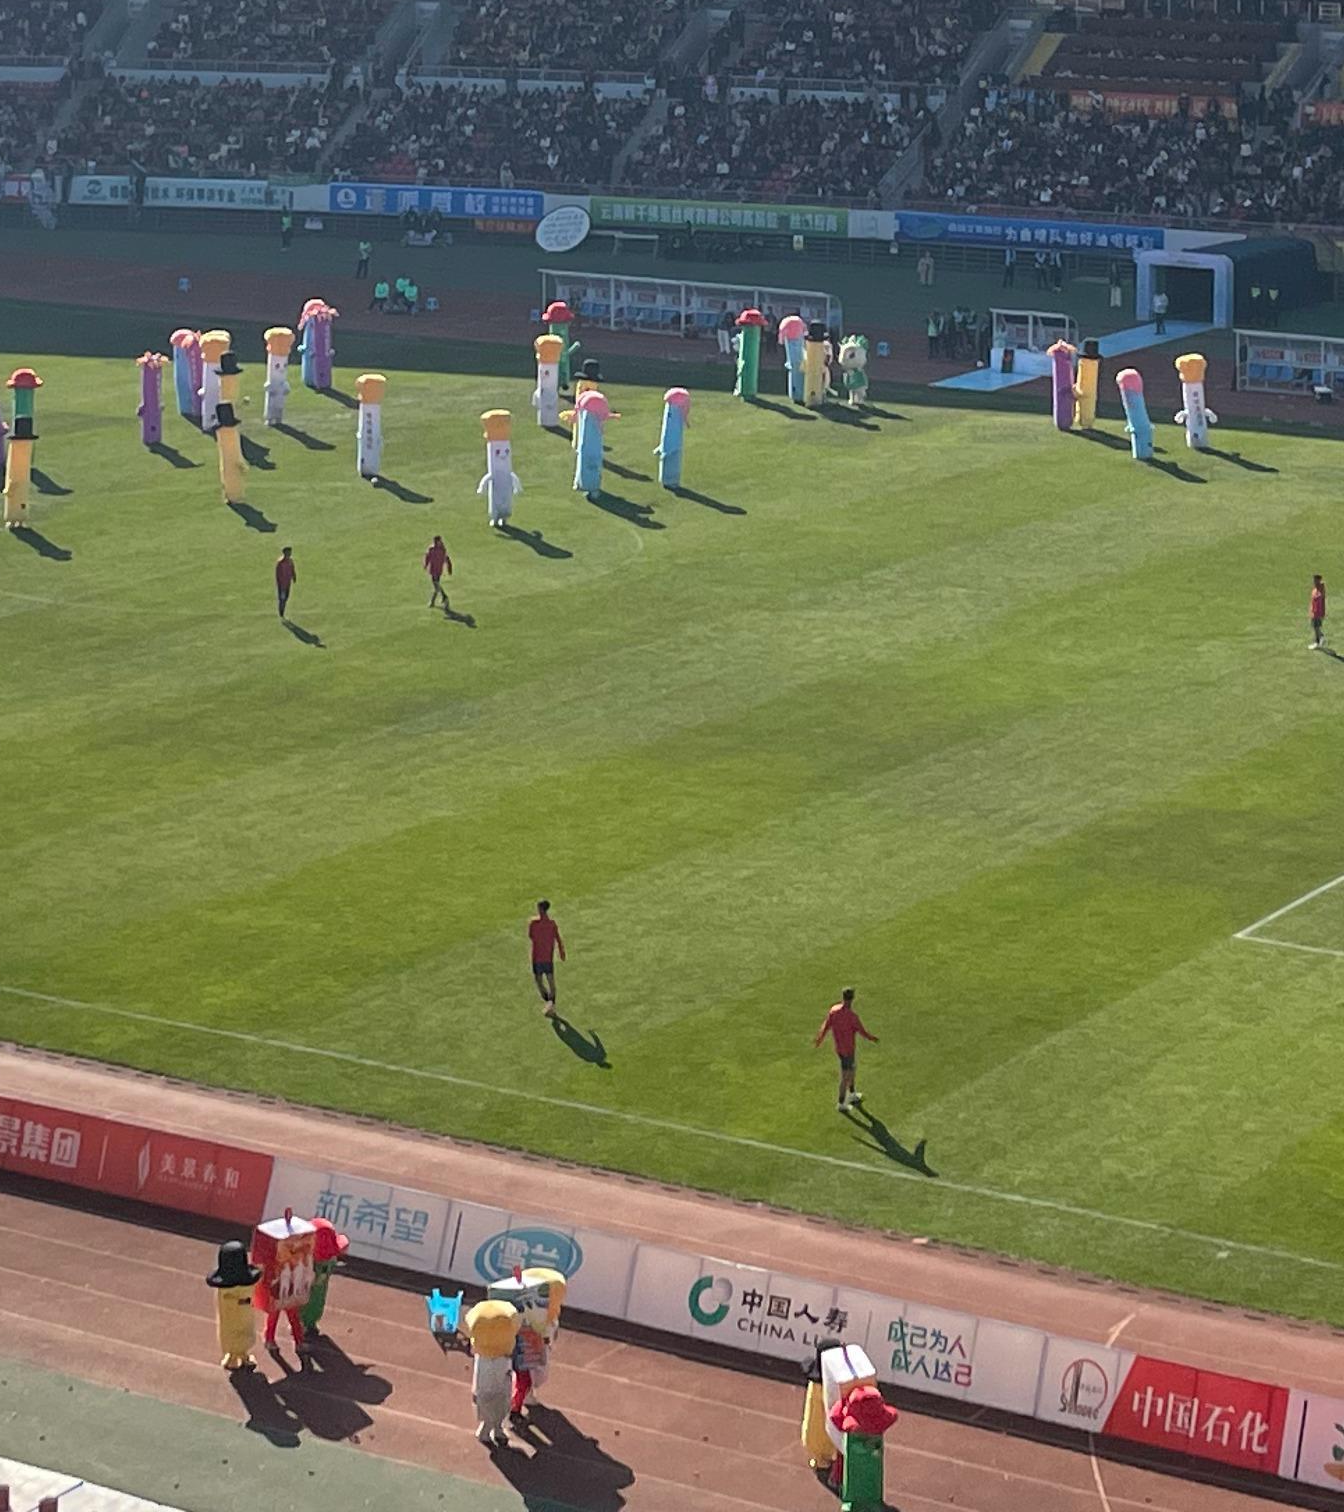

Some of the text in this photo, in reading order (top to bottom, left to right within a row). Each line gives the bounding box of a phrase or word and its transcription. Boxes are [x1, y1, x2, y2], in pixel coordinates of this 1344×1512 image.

[314, 1188, 430, 1245] 新希望
[737, 1317, 795, 1342] CHINA
[741, 1288, 848, 1333] 中国人寿
[888, 1317, 966, 1359] 成己为人
[891, 1348, 972, 1387] 成人达己
[1132, 1384, 1269, 1455] 中国石化
